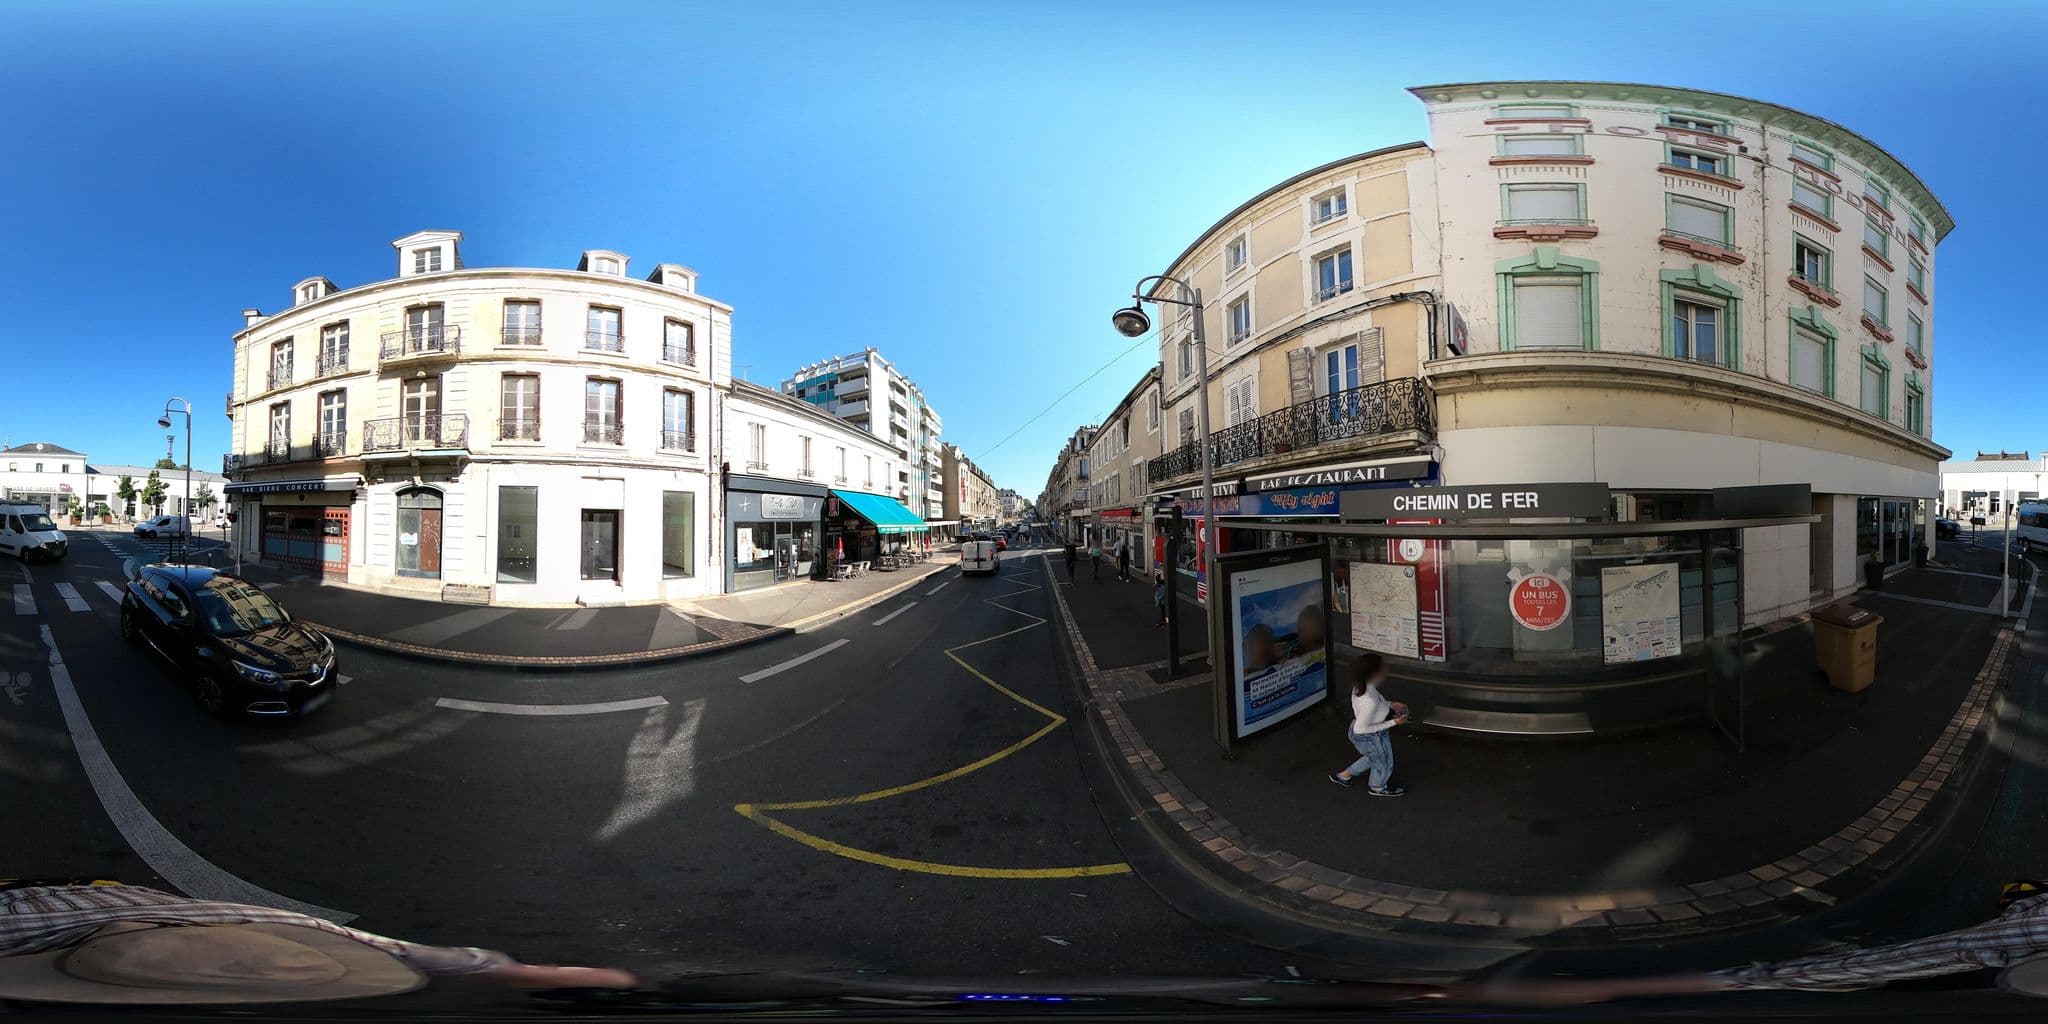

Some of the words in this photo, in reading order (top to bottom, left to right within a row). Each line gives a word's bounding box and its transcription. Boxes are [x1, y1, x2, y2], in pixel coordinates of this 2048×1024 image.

[1794, 163, 1918, 258] MODERNE
[286, 483, 324, 491] CONCERT
[1191, 484, 1237, 499] BROKLYN
[1393, 494, 1459, 511] CHEMIN
[1467, 493, 1493, 509] DE
[1501, 492, 1539, 509] FER
[1521, 591, 1536, 599] UN
[1538, 591, 1558, 599] BUS
[1536, 606, 1545, 617] 7
